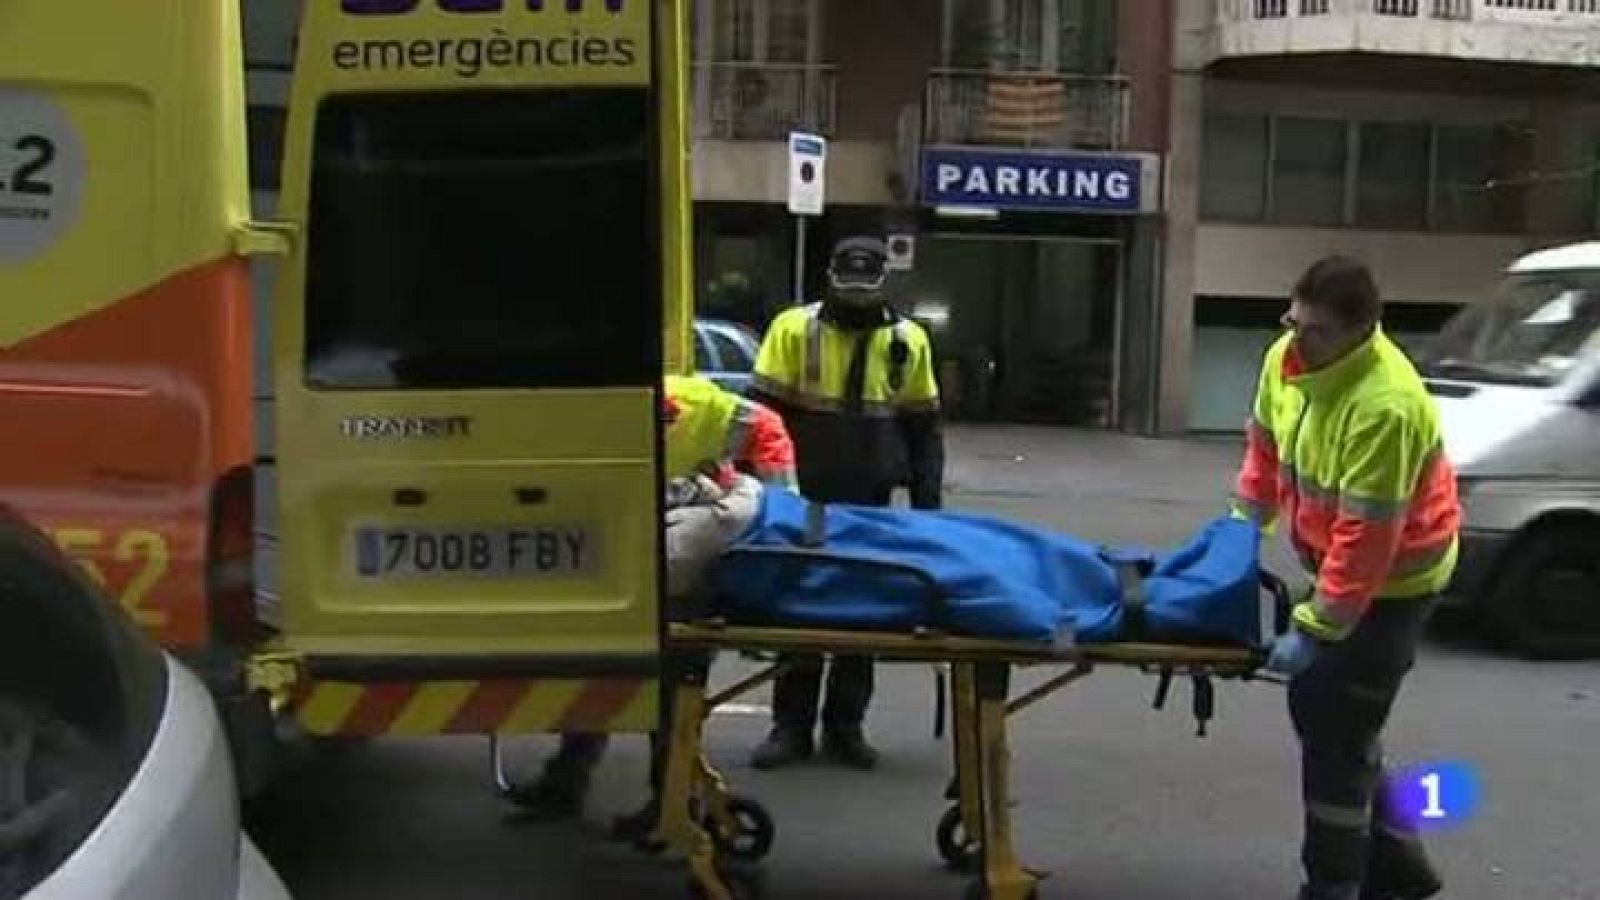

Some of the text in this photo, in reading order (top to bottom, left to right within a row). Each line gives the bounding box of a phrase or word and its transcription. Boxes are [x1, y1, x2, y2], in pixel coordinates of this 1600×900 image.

[332, 28, 636, 78] emergències
[936, 163, 1131, 199] PARKING
[386, 530, 585, 571] 7008 FBY
